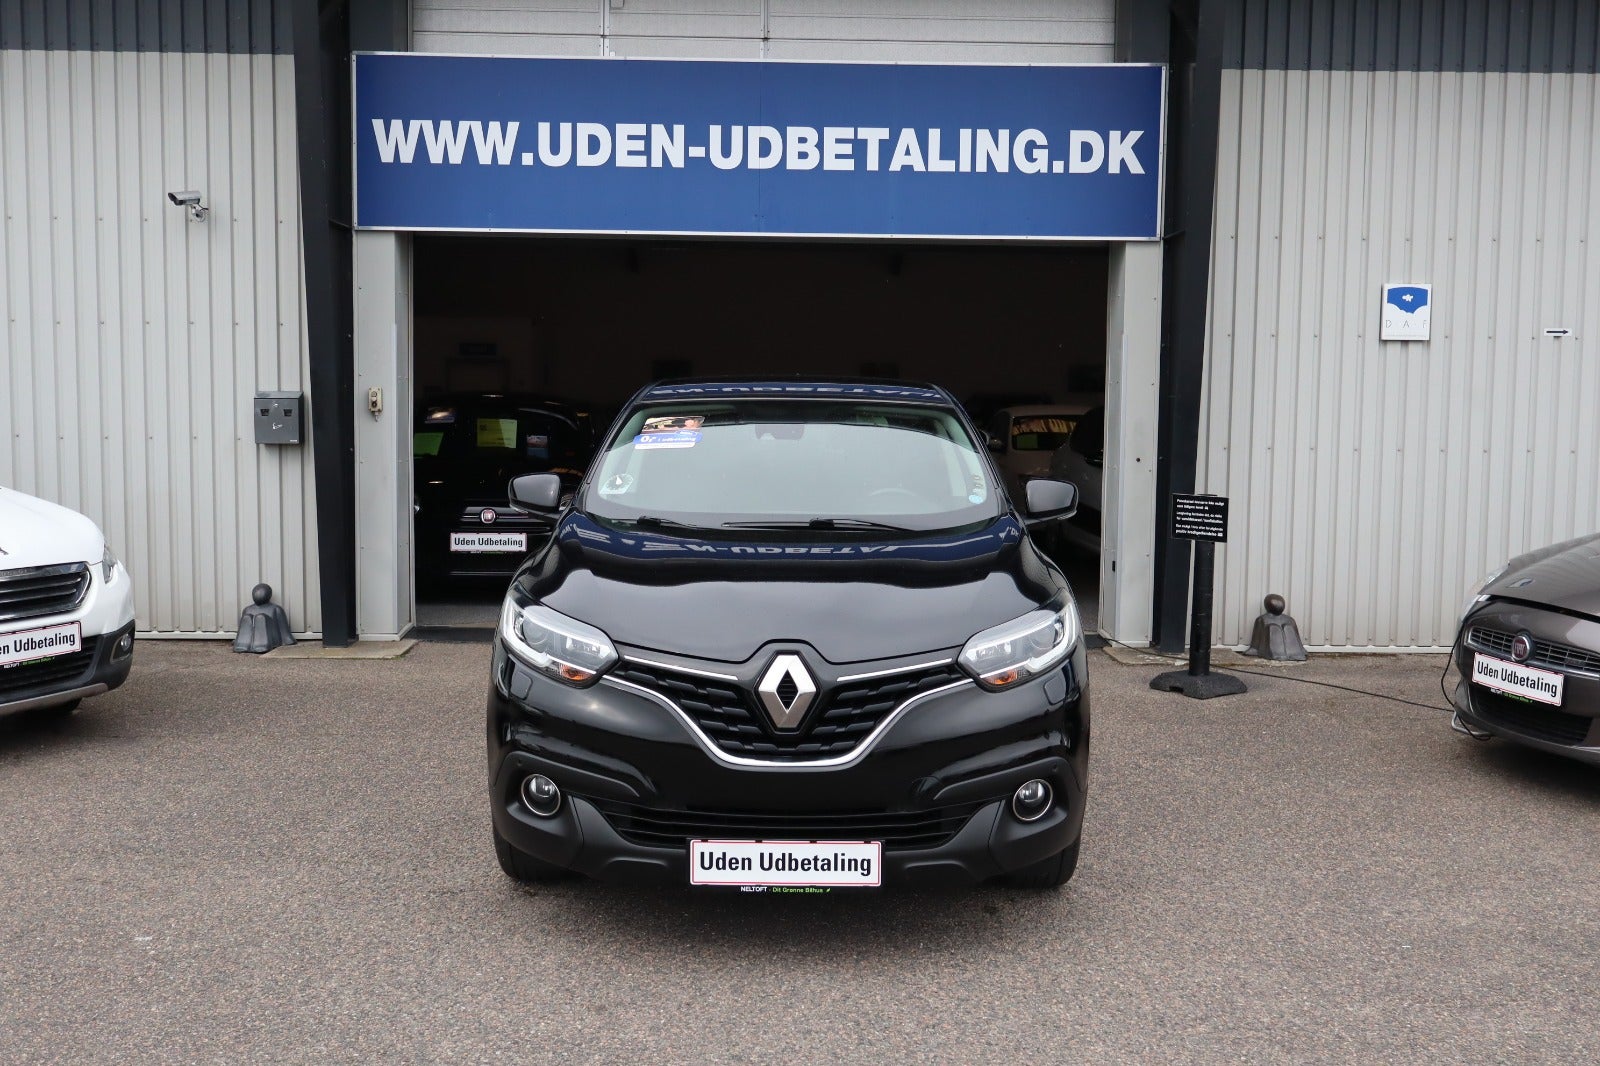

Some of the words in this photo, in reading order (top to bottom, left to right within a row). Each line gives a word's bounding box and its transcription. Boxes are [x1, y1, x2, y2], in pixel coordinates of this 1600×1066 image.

[371, 118, 1146, 175] WWW.UDEN-UDBETALING.DK
[454, 537, 475, 546] Uden
[478, 537, 523, 547] Udbetaling
[14, 633, 75, 653] Udbetaling
[1477, 660, 1499, 679] Uden
[1501, 668, 1557, 697] Udbetaling
[700, 851, 752, 871] Uden
[759, 852, 872, 877] Udbetaling
